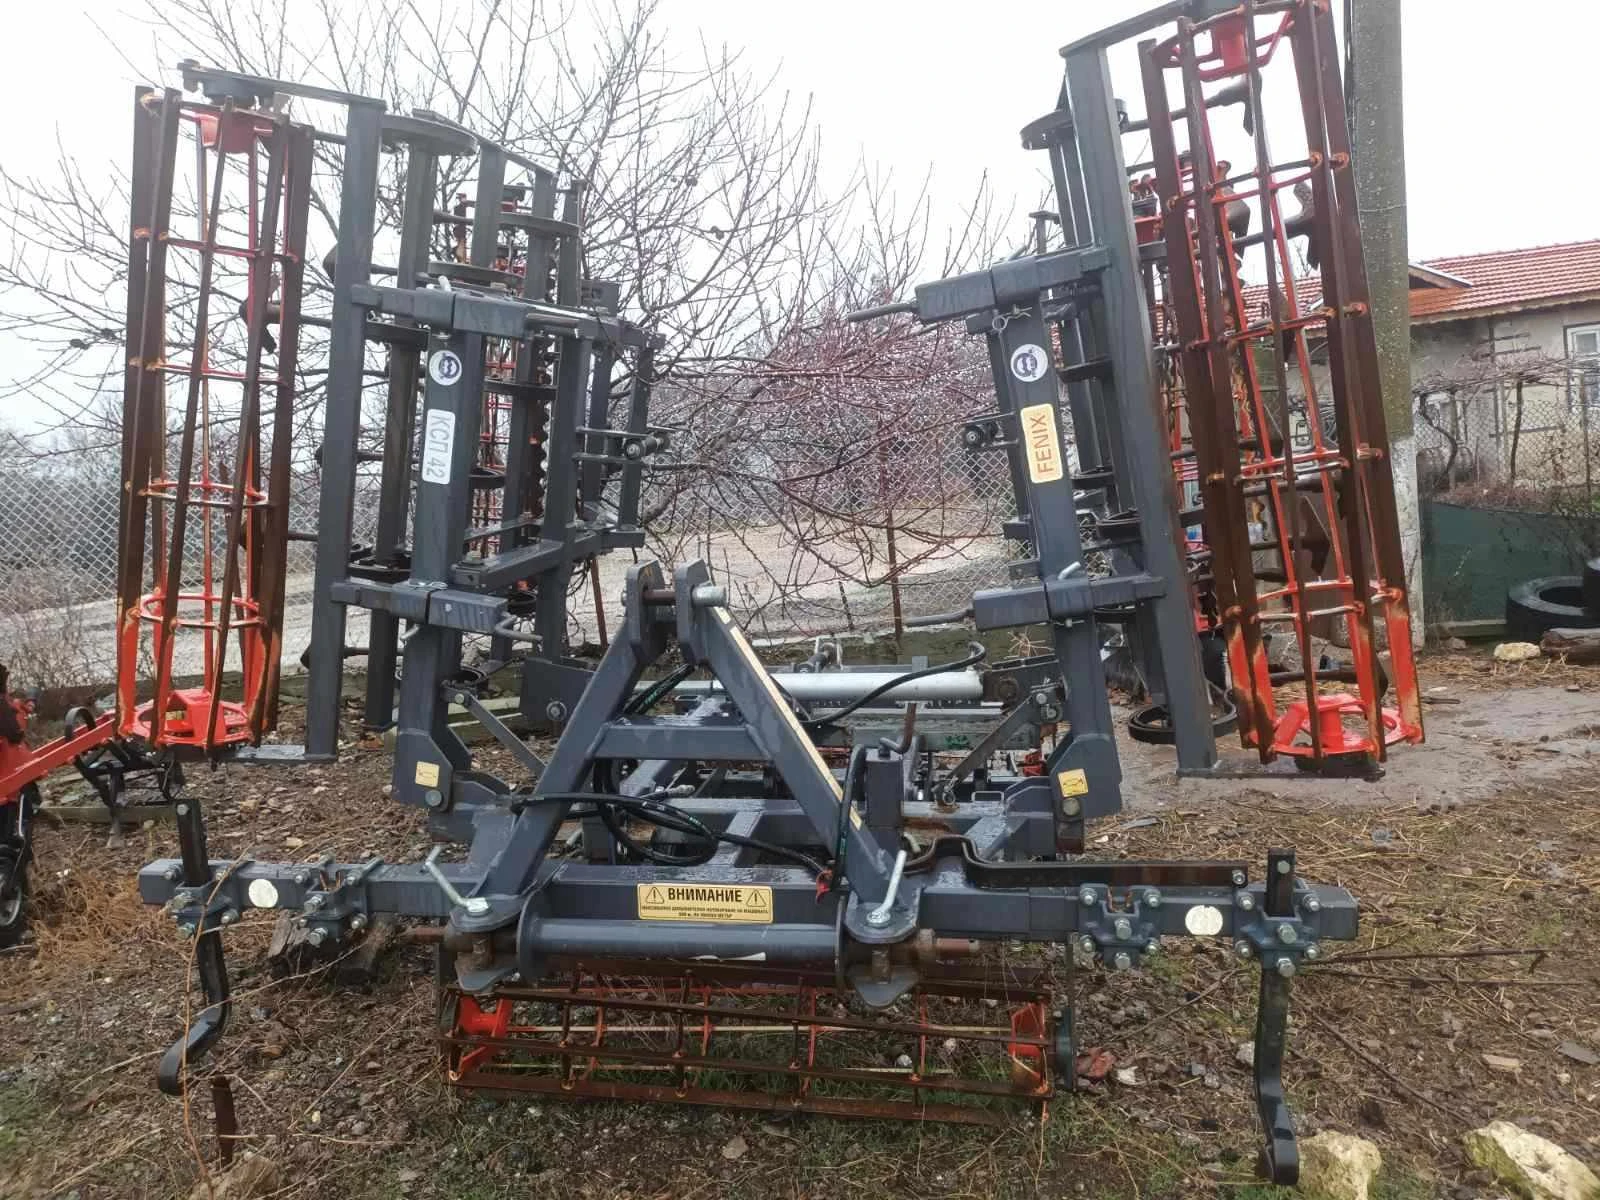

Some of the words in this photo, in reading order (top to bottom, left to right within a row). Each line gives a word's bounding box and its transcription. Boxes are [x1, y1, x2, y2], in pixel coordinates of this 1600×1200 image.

[429, 415, 450, 453] КСП
[1030, 415, 1054, 473] FENIX
[427, 458, 446, 478] 42
[668, 887, 742, 902] ВНИМАНИЕ
